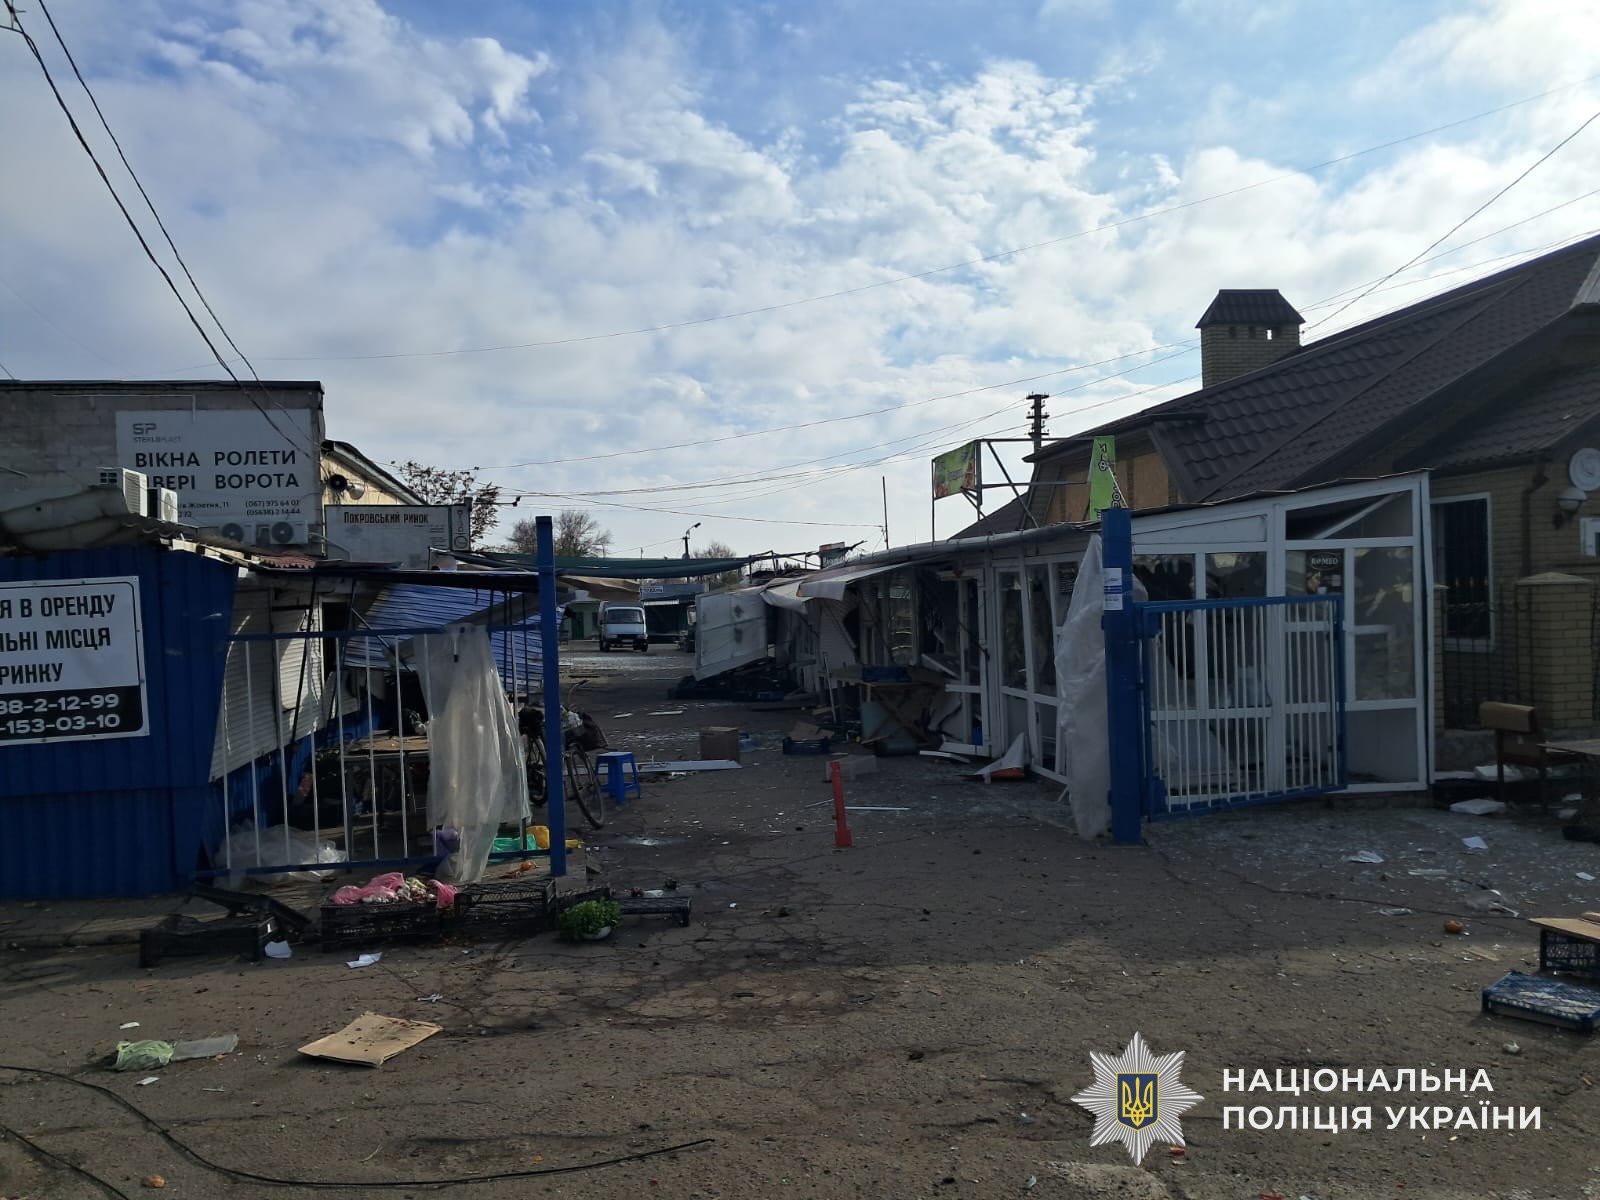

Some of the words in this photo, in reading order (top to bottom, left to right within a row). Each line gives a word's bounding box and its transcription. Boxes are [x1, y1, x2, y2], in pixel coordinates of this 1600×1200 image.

[136, 452, 200, 468] ВІКНА
[214, 450, 296, 466] РОЛЕТИ
[215, 473, 299, 490] ВОРОТА
[20, 599, 33, 618] В
[40, 594, 115, 618] ОРЕНДУ
[0, 631, 38, 652] ЬНІ
[46, 628, 111, 650] МІСЦЯ
[0, 663, 63, 685] РИНКУ
